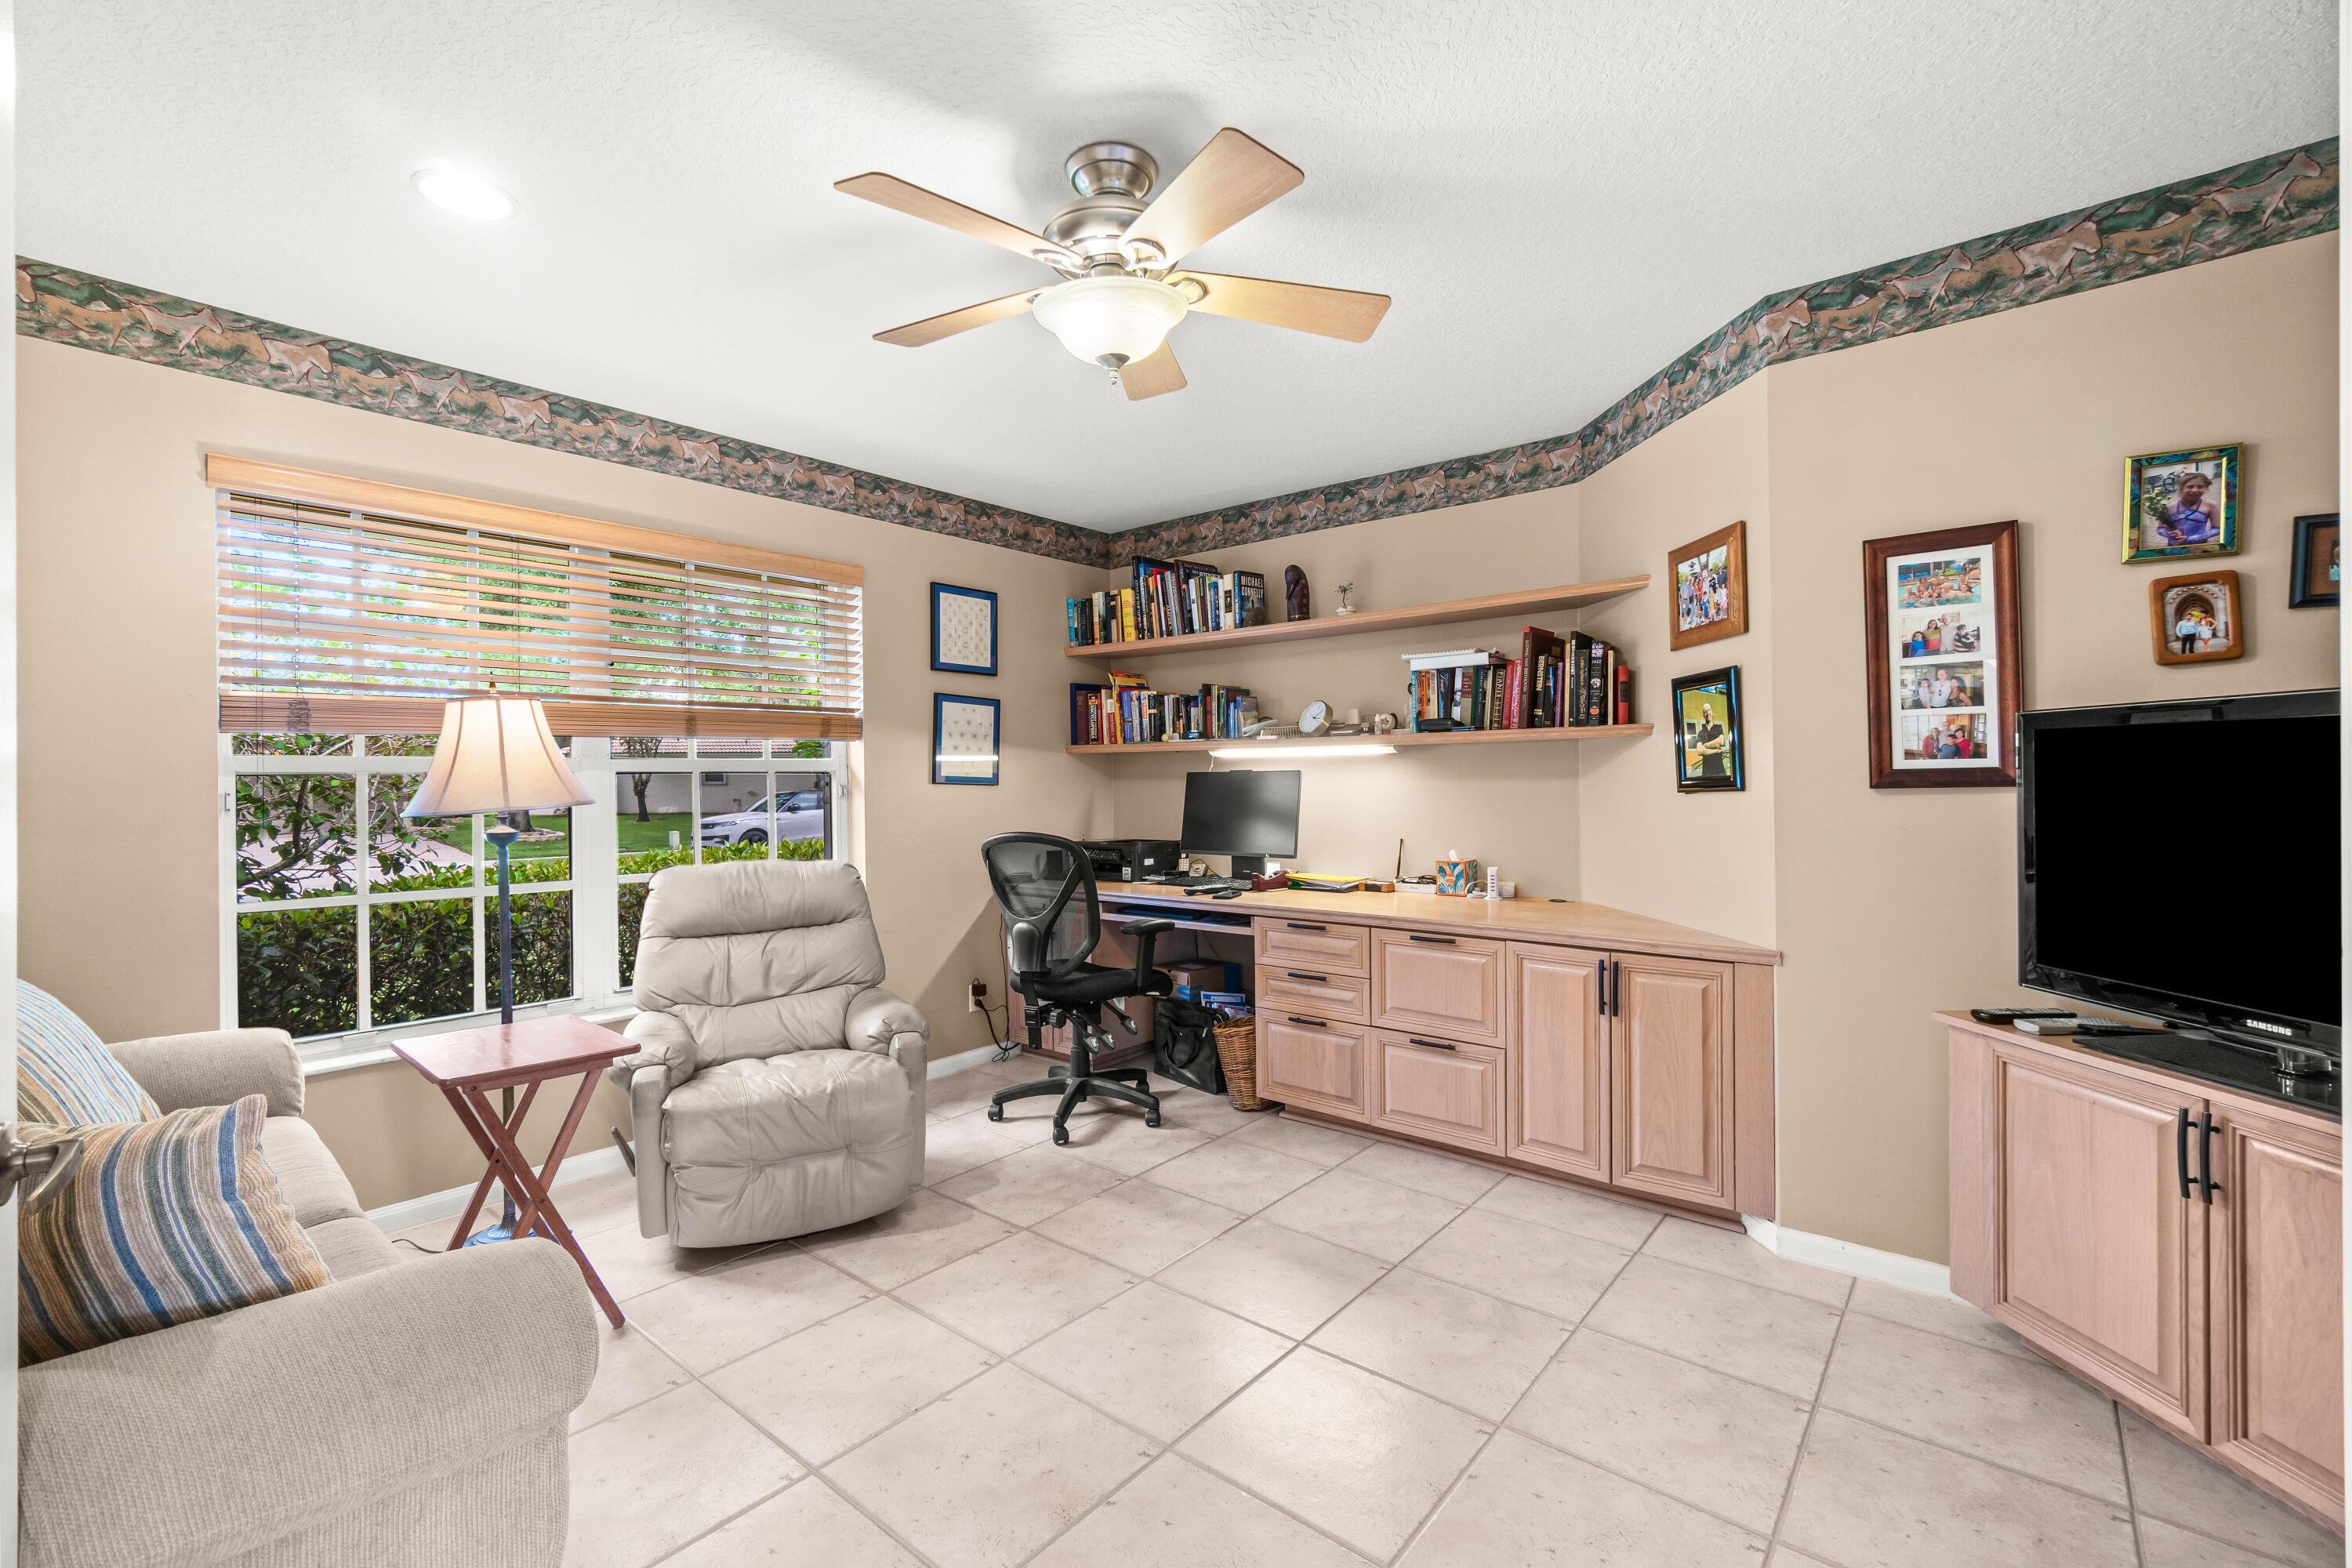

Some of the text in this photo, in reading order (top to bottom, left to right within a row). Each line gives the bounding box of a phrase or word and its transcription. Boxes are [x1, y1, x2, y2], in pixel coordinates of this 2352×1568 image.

[1241, 575, 1263, 588] MICHAEL
[1241, 586, 1264, 598] CONNELLY
[1536, 655, 1545, 691] BERNSTEIN
[2245, 1019, 2292, 1036] SAMSUNG
